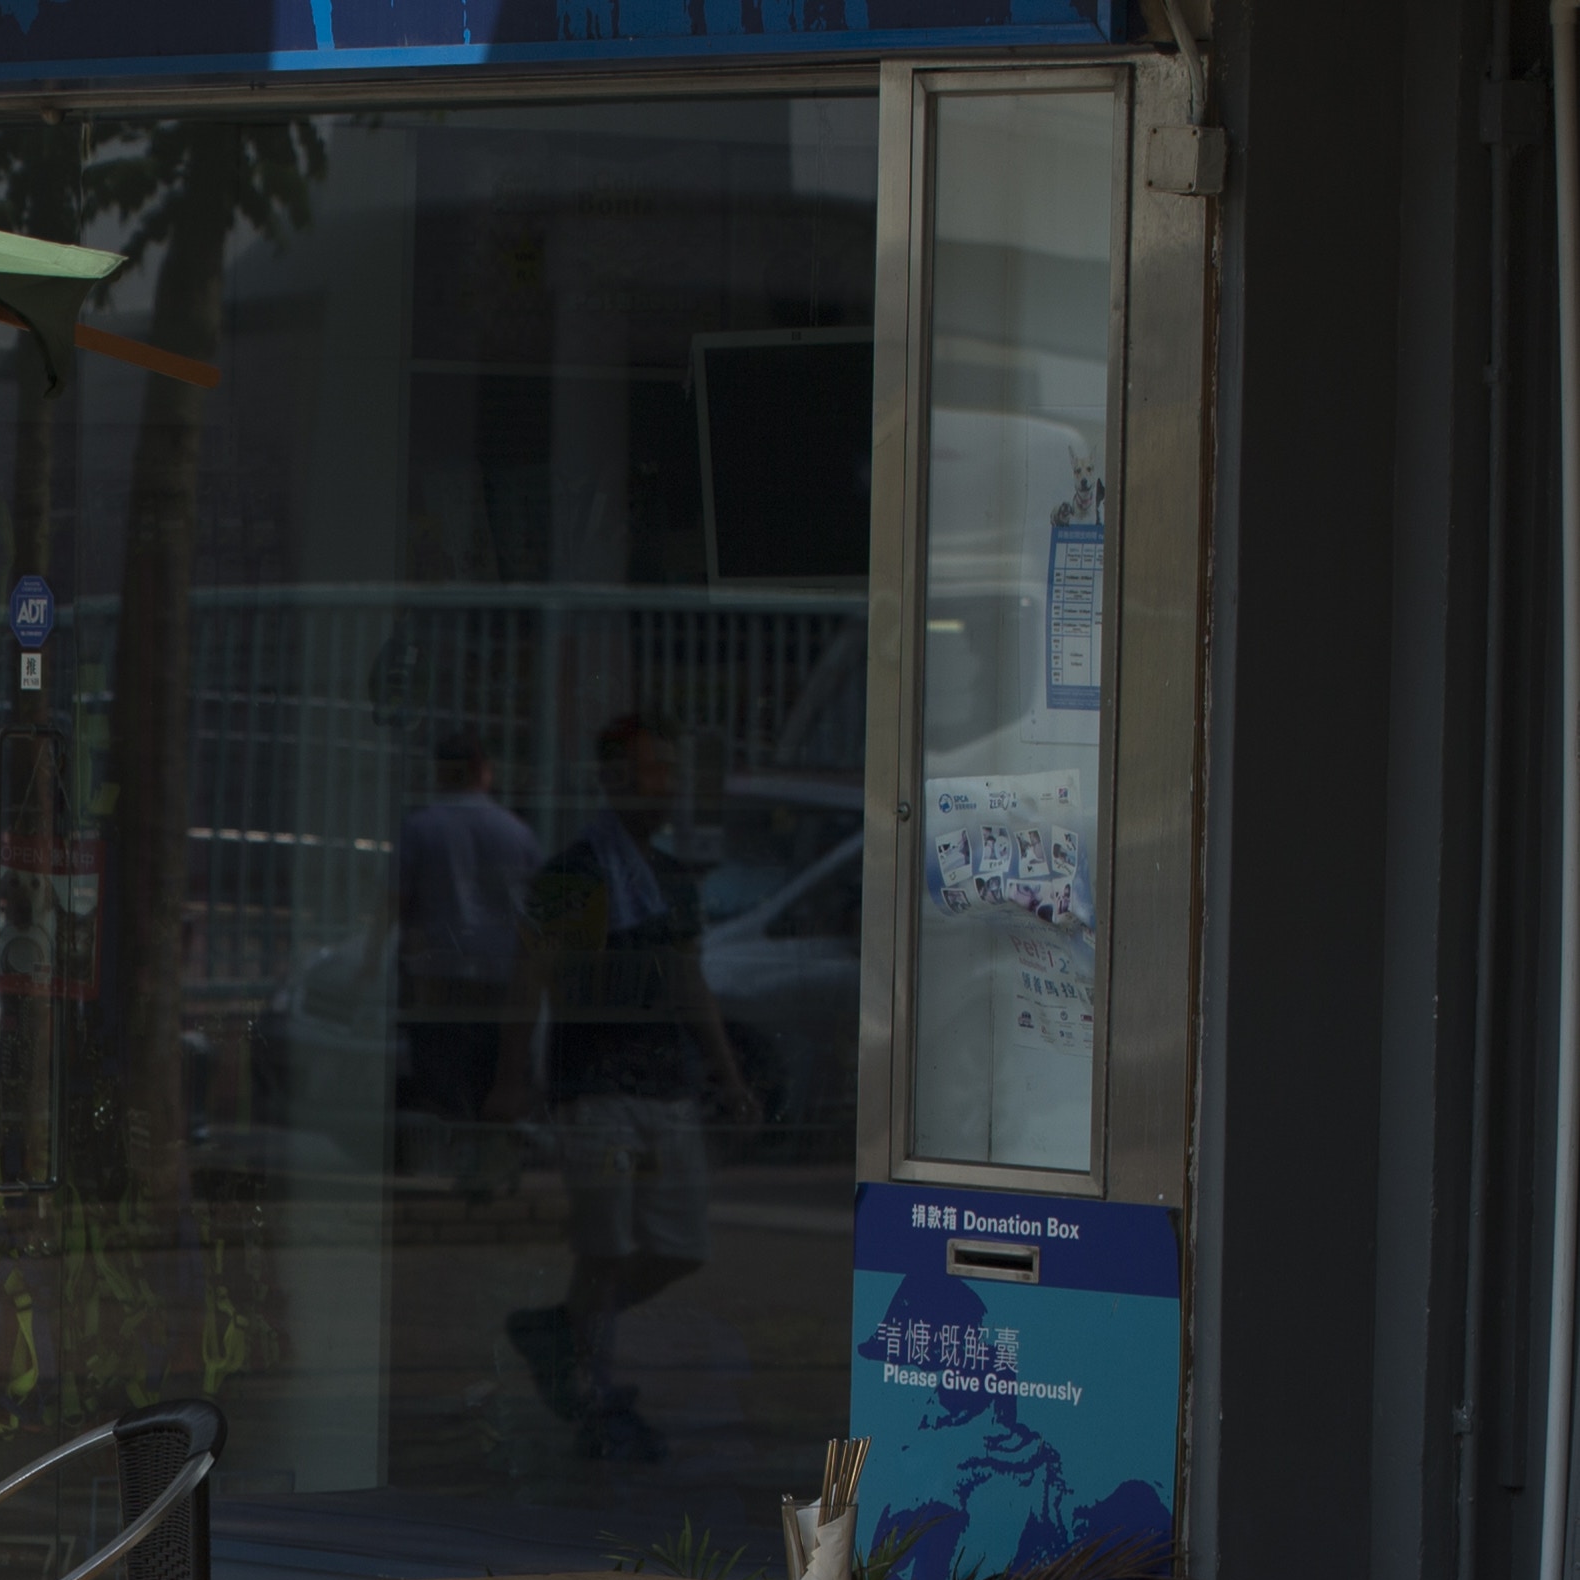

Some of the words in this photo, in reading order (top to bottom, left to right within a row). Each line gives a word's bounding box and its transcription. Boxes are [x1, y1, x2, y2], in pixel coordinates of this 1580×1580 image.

[17, 598, 47, 625] ADT
[0, 847, 44, 864] OPEN
[912, 1203, 957, 1231] 捐款箱
[963, 1210, 1042, 1236] Donation
[1046, 1217, 1080, 1240] Box
[877, 1317, 1021, 1374] 請慷慨解囊
[883, 1363, 937, 1388] Please
[942, 1369, 980, 1392] Give
[984, 1373, 1083, 1407] Generously
